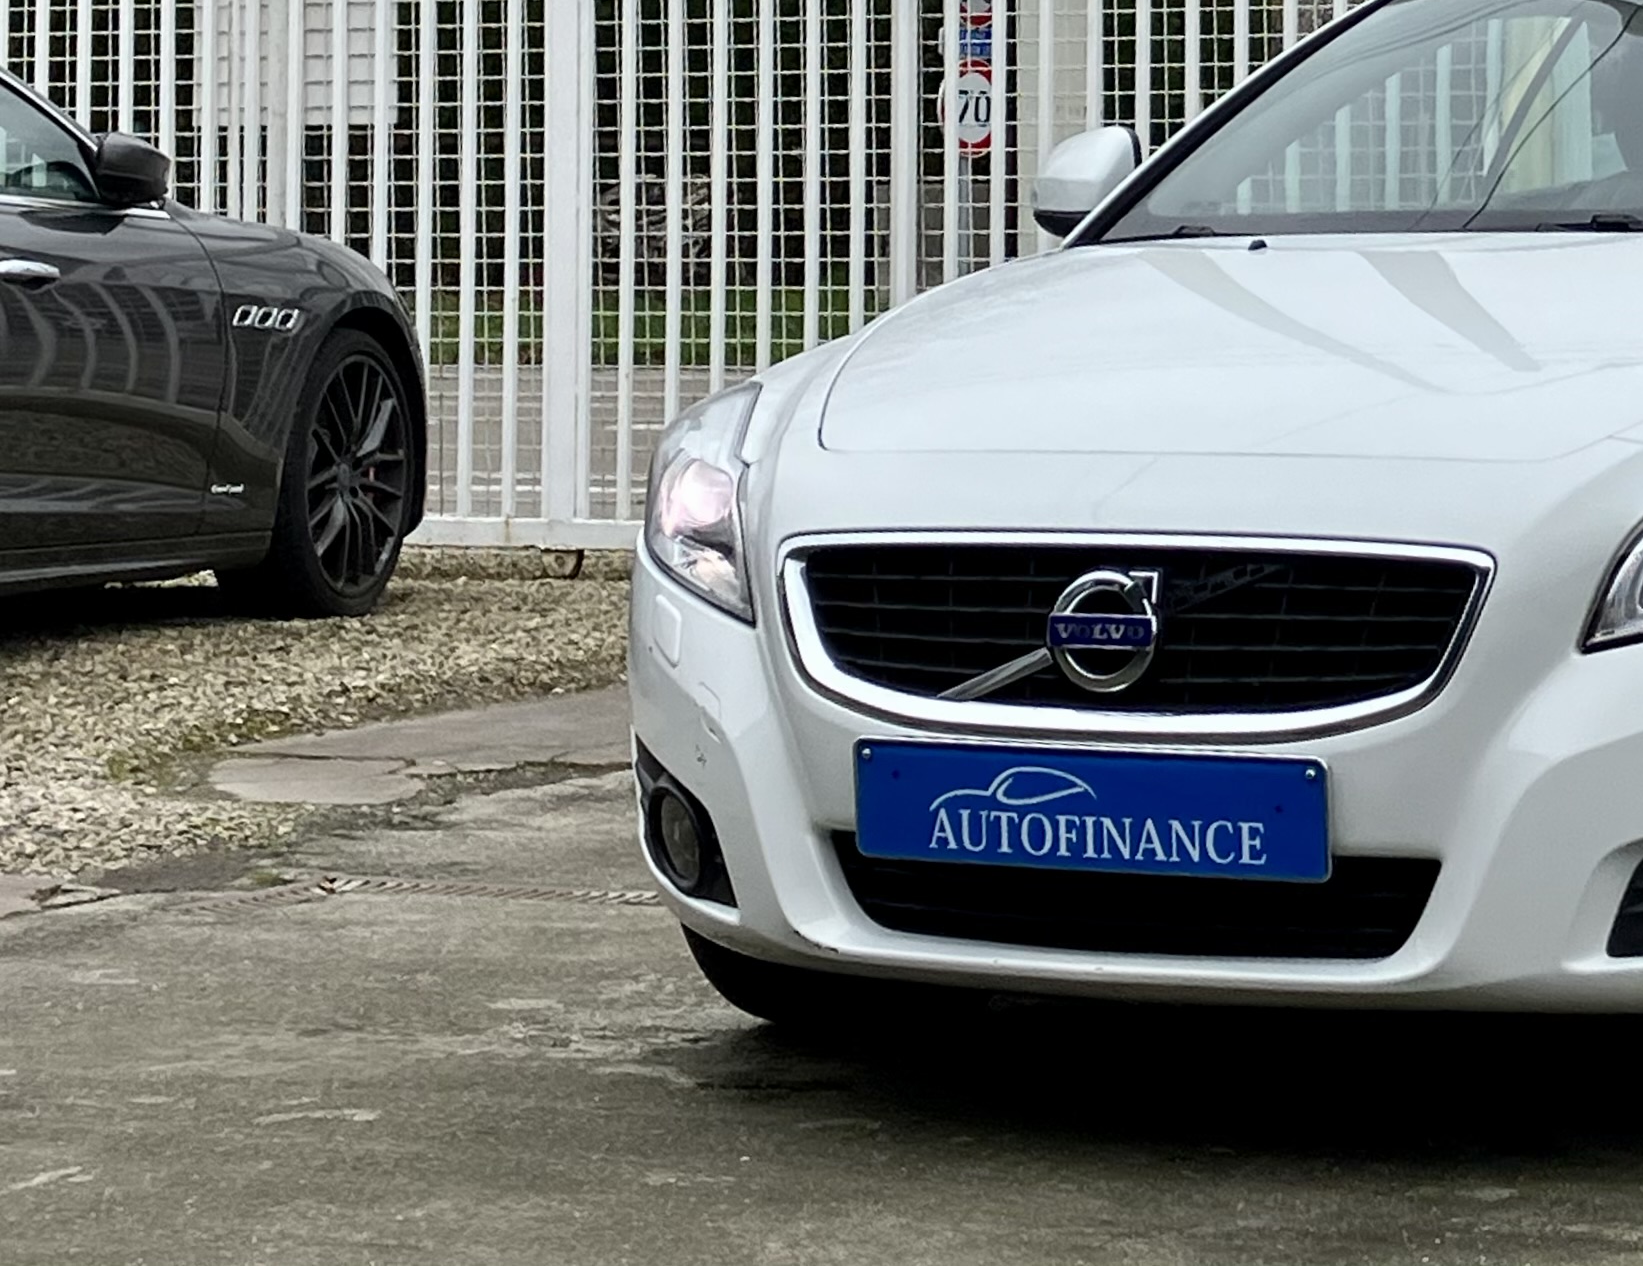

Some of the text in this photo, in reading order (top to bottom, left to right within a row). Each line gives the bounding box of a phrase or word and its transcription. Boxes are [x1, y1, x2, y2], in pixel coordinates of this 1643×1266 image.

[957, 89, 992, 128] 70
[1054, 622, 1145, 640] VOLVO
[929, 807, 1267, 865] AUTOFINANCE
